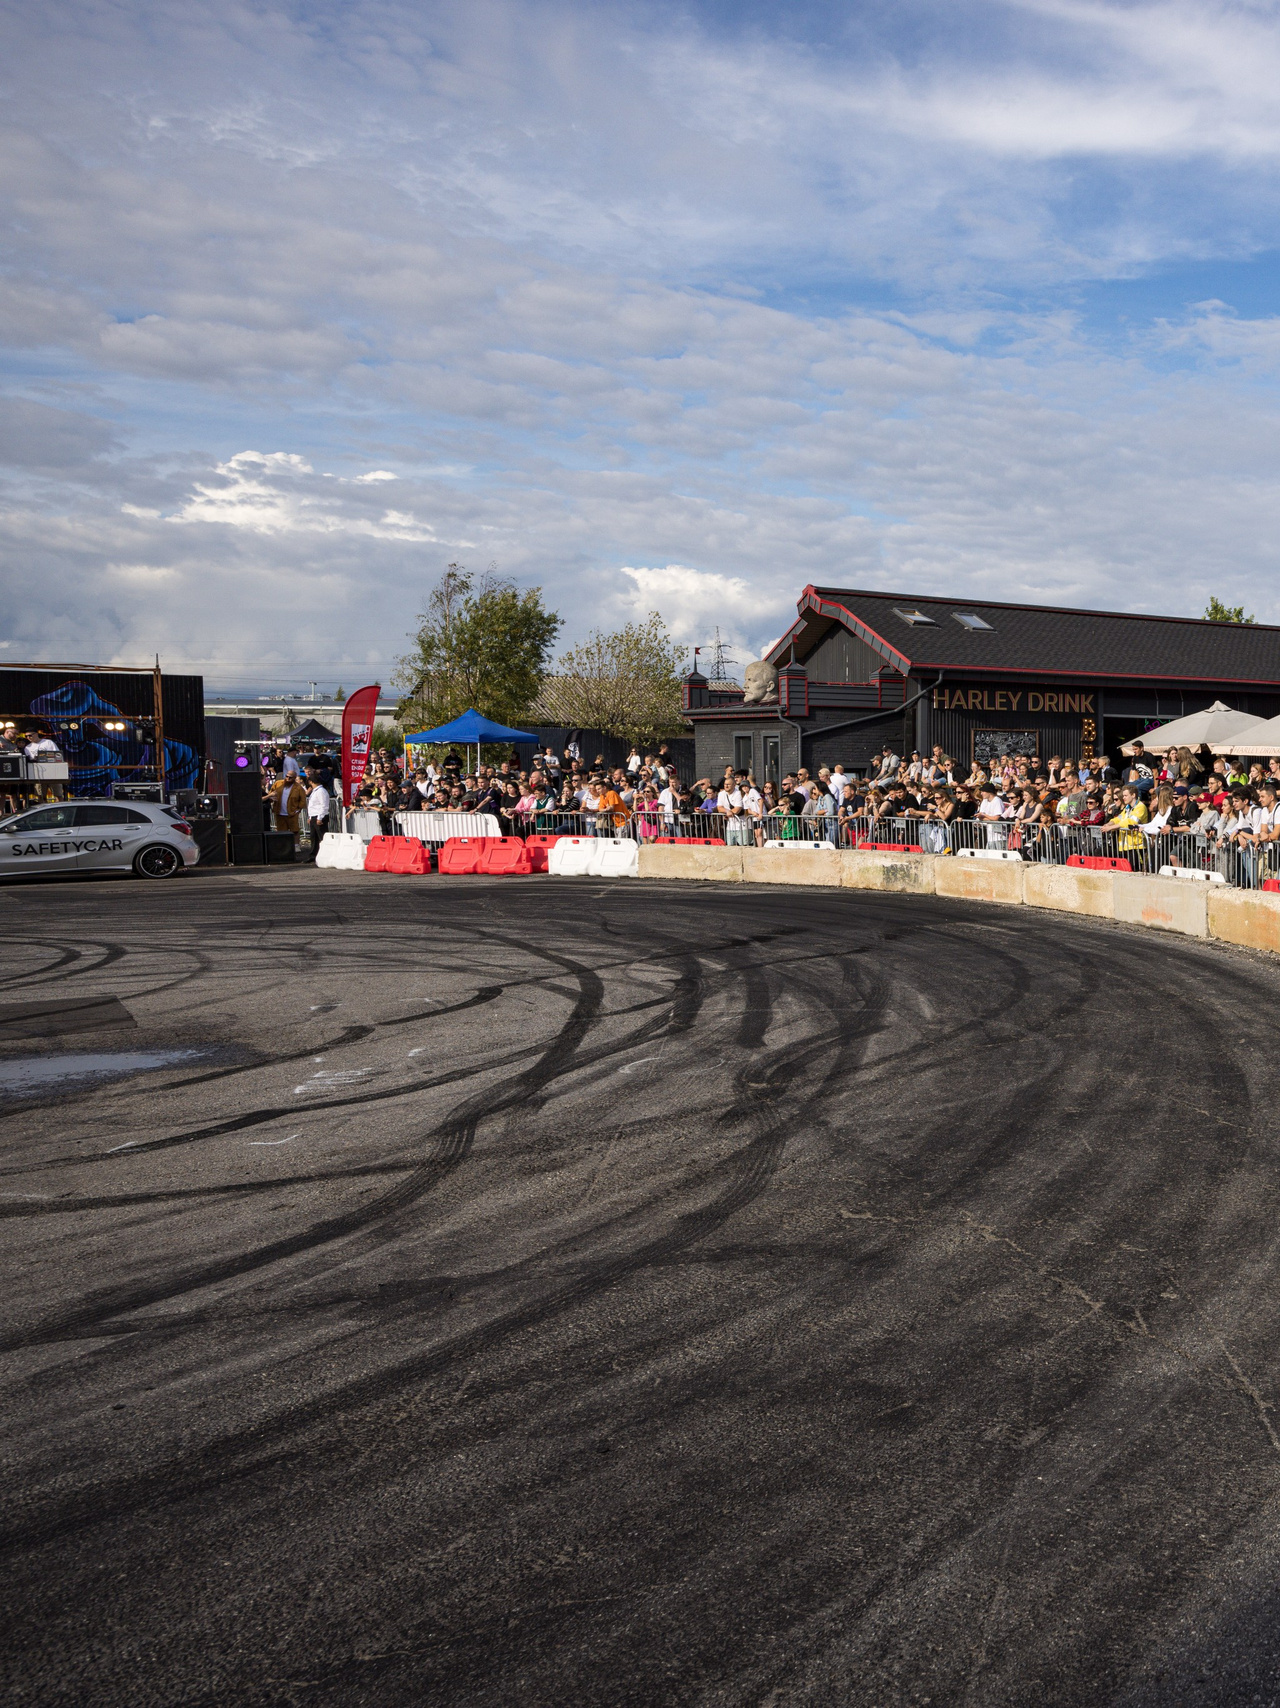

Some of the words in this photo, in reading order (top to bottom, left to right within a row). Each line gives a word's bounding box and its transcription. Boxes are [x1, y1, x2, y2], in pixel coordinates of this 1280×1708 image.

[933, 688, 1022, 711] HARLEY
[1028, 692, 1095, 713] DRINK
[1233, 746, 1258, 754] HARLEY
[1260, 747, 1280, 755] DRINK
[12, 839, 123, 856] SAFETYCAR
